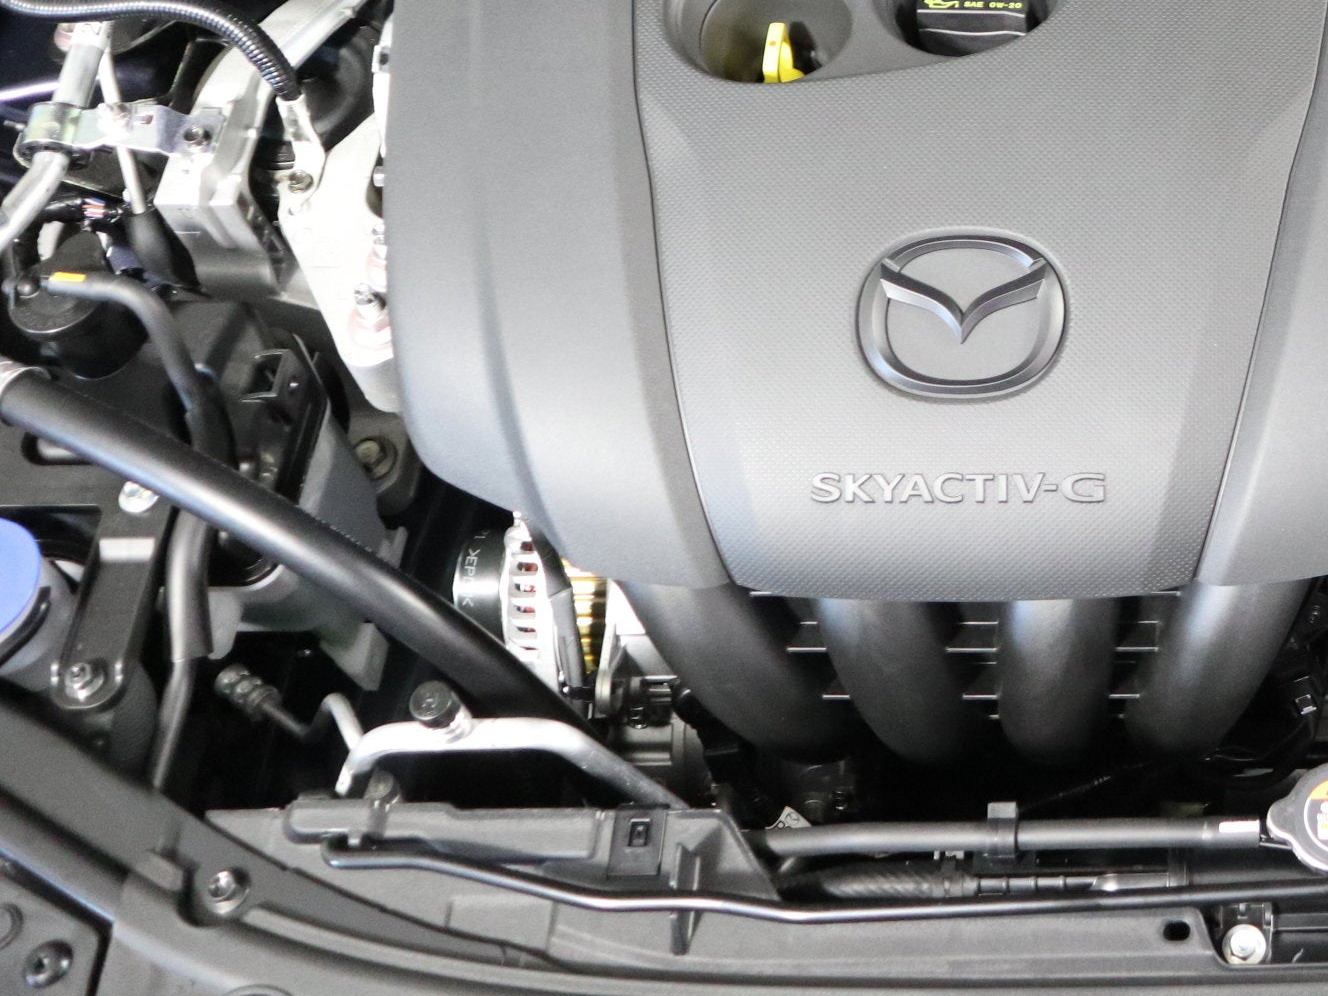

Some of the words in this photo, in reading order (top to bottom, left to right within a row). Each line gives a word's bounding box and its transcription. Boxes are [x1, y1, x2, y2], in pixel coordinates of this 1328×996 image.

[963, 0, 985, 8] SAE
[988, 1, 1023, 9] 0W-20
[810, 472, 1106, 504] SKYACTIV-G
